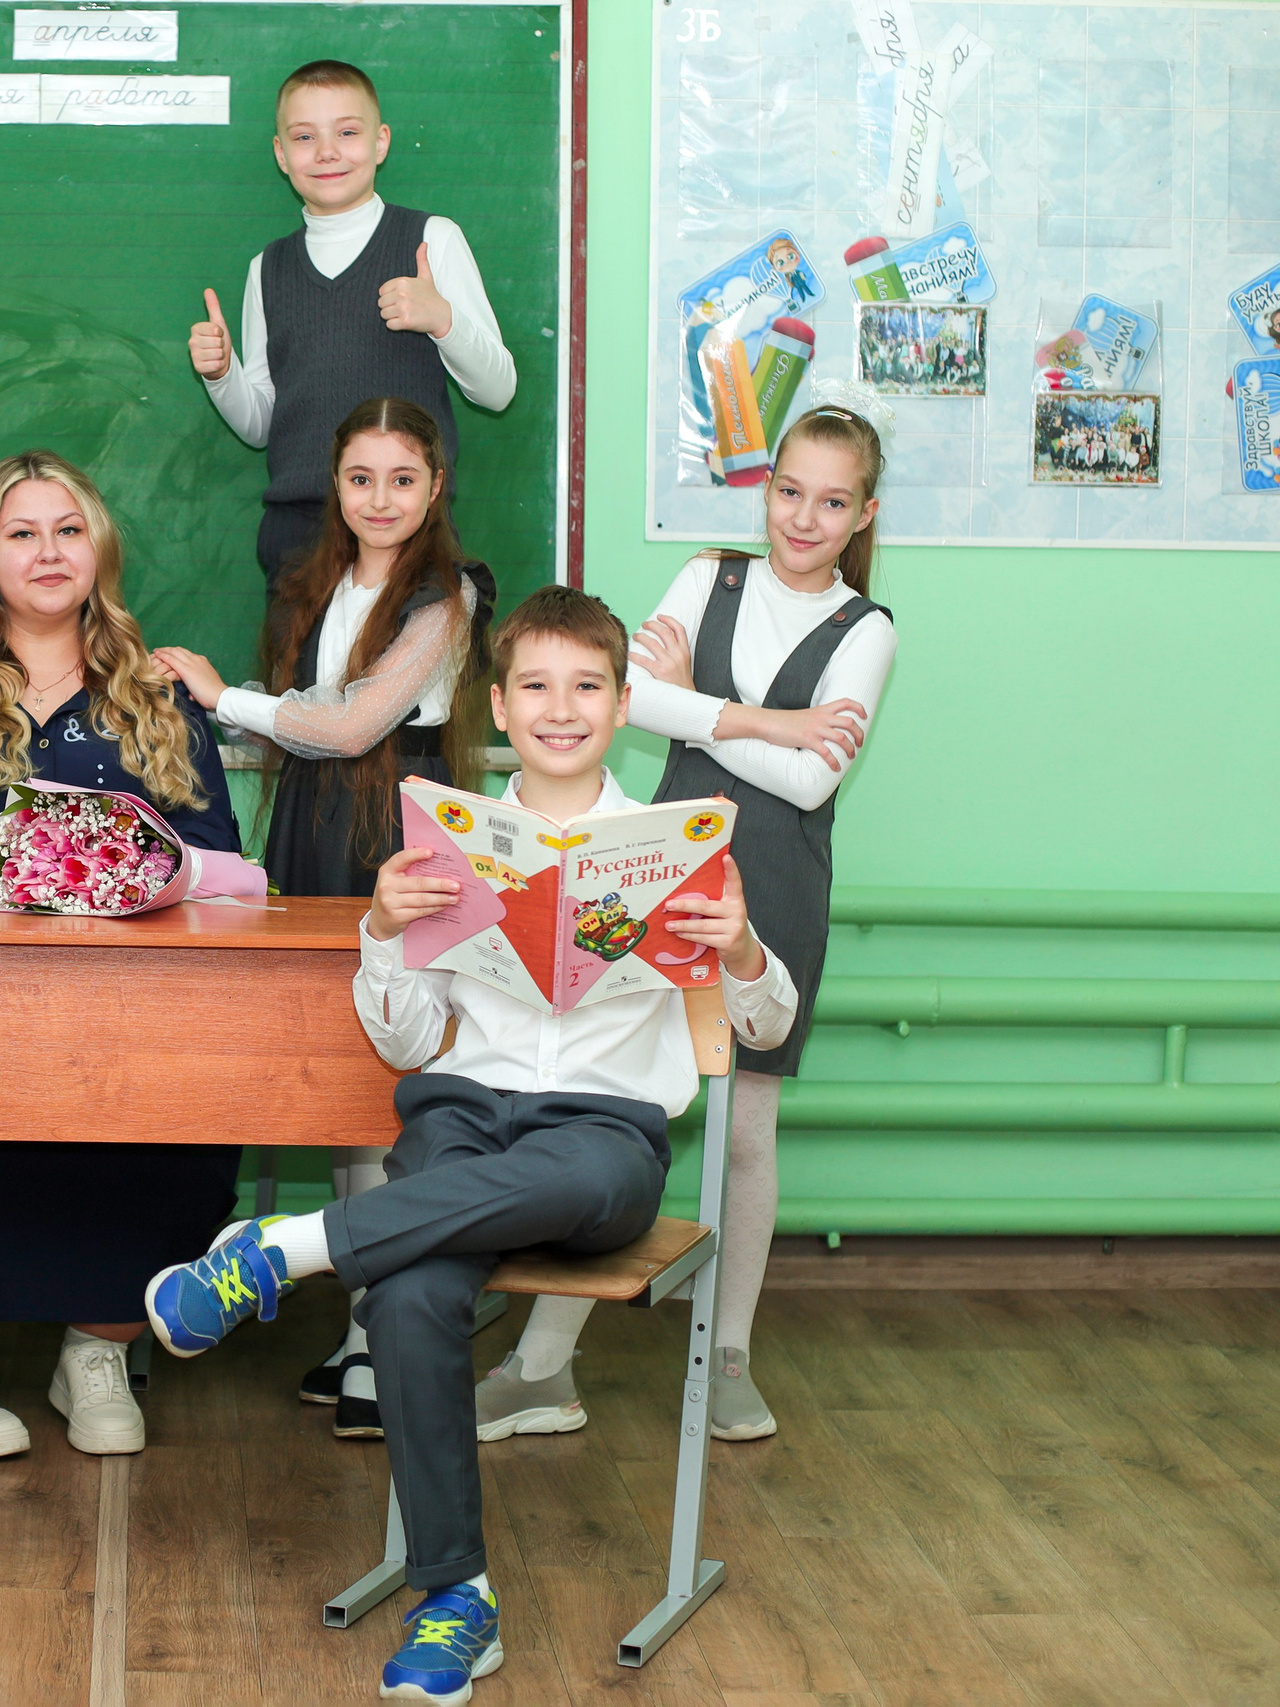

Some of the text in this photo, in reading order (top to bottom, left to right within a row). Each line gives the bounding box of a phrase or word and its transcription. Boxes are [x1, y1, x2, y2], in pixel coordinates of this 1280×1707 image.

[55, 77, 197, 121] работа
[901, 246, 978, 282] австречу
[909, 261, 977, 297] наниям!
[475, 862, 493, 873] Ох
[502, 872, 518, 885] Ах
[575, 850, 665, 880] Русский
[568, 972, 580, 988] 2
